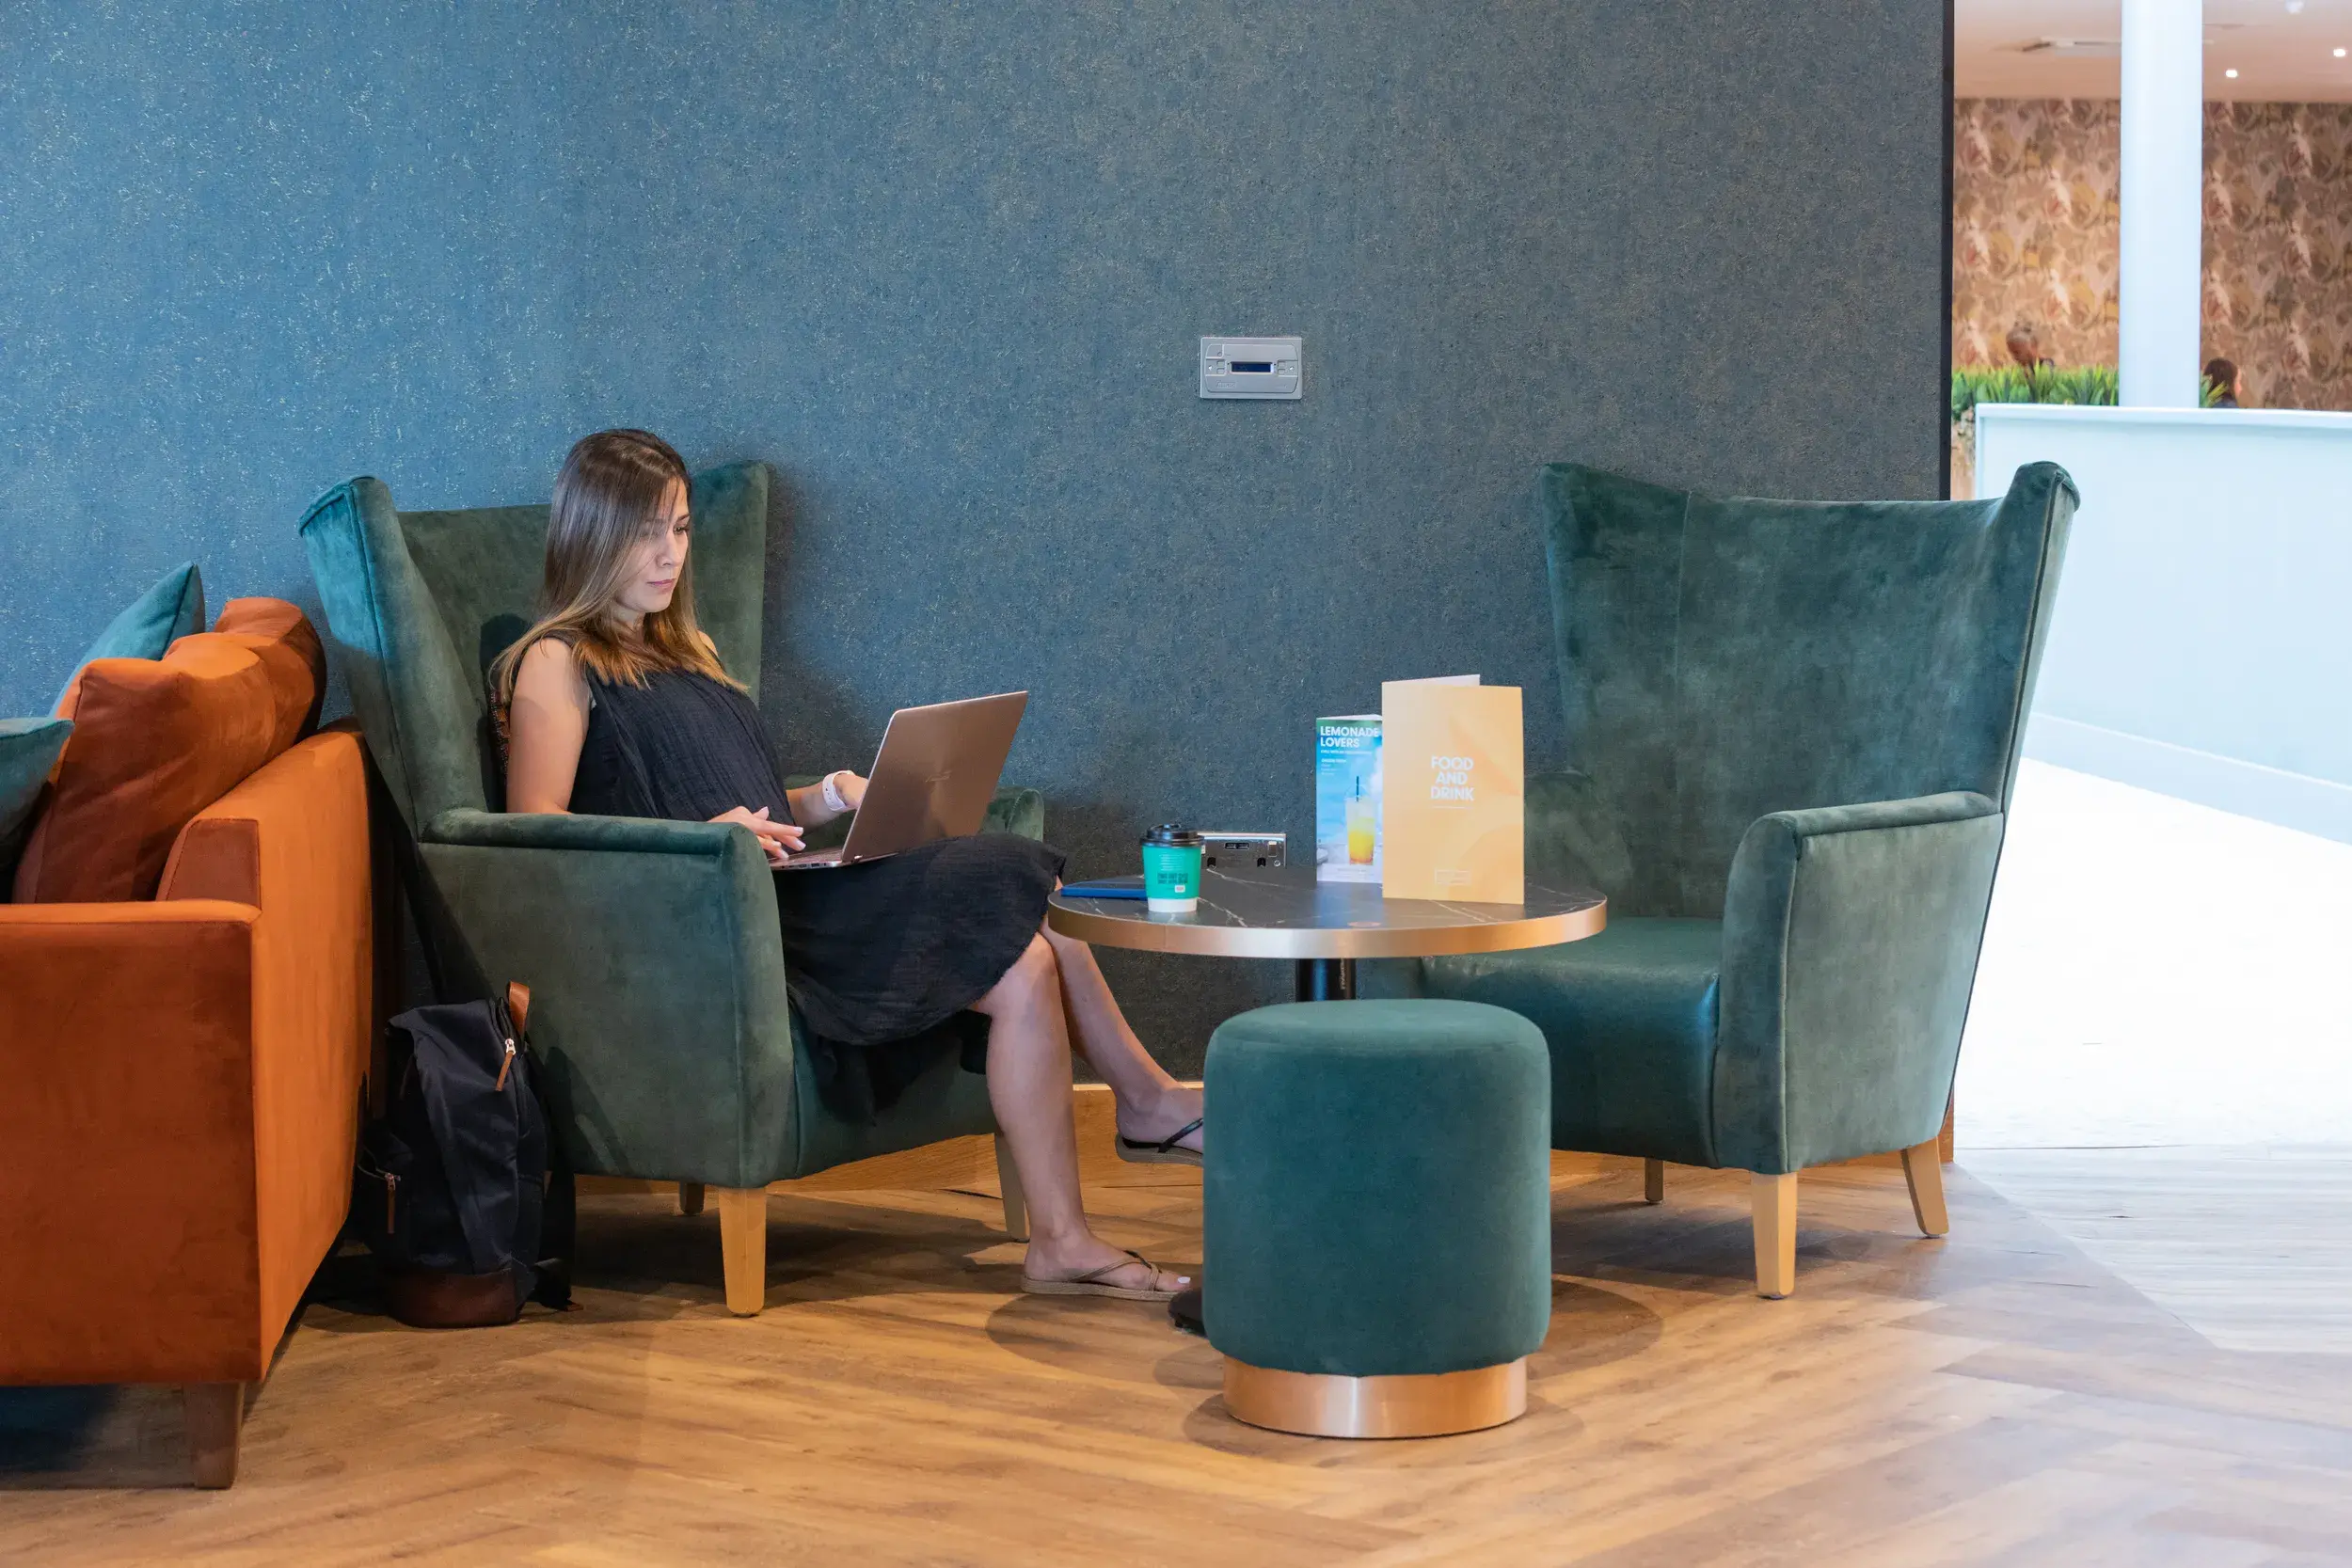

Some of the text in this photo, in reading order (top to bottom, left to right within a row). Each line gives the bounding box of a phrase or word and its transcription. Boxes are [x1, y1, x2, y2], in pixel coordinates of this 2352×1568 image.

[1320, 726, 1379, 737] LEMONADE
[1320, 736, 1360, 748] LOVERS
[1431, 755, 1474, 770] FOOD
[1436, 771, 1468, 785] AND
[1431, 786, 1474, 800] DRINK
